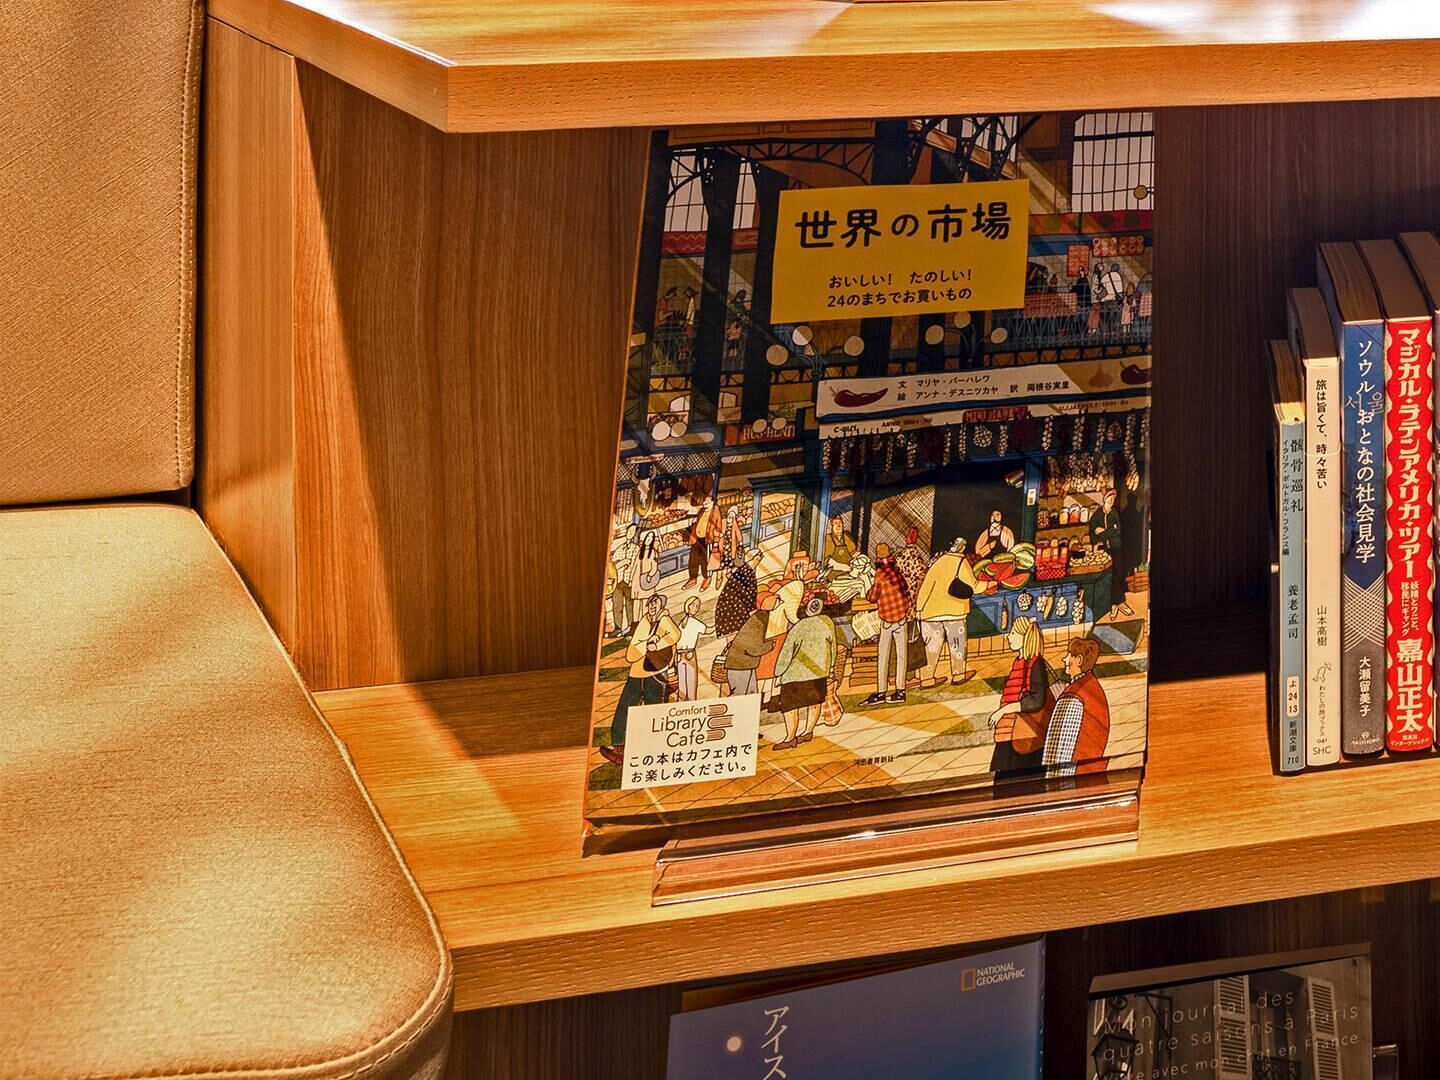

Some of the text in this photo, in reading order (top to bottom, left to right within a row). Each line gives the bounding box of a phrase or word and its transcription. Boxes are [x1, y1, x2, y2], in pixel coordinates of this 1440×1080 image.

[794, 201, 1012, 249] 世界の市場
[828, 268, 972, 289] おいしい！ たのしい！
[827, 287, 972, 308] 24のまちでお買いもの
[896, 391, 907, 402] 絵
[1010, 384, 1019, 394] 訳
[897, 380, 907, 390] 文
[1316, 379, 1328, 490] 旅は旨くて、時々苦い
[1355, 340, 1376, 563] ソウル おとなの社会見学
[1398, 328, 1422, 579] マジカル・ラテンアメリカ・ツアー
[1290, 438, 1304, 513] 骸骨巡礼
[1287, 583, 1299, 640] 養老孟司
[1316, 605, 1328, 647] 山本高樹
[1288, 692, 1298, 701] 24
[1359, 656, 1372, 718] 大瀬留美子
[1396, 638, 1424, 733] 嘉山正太
[668, 705, 707, 718] Comfort
[1288, 705, 1298, 714] 13
[651, 715, 708, 733] Library
[666, 728, 705, 748] Cafe
[629, 743, 753, 768] この本はカフェ内で
[1287, 756, 1299, 765] 710
[1312, 746, 1332, 756] SHC
[631, 761, 747, 783] お楽しみください。
[976, 962, 1015, 977] NATIONAL
[976, 968, 1025, 987] GEOGRAPHIC
[1164, 995, 1245, 1031] journal
[1256, 991, 1294, 1010] des
[1103, 1033, 1179, 1063] quatre
[1306, 1003, 1359, 1025] Paris
[1152, 1063, 1188, 1079] avec
[1305, 1032, 1358, 1052] France
